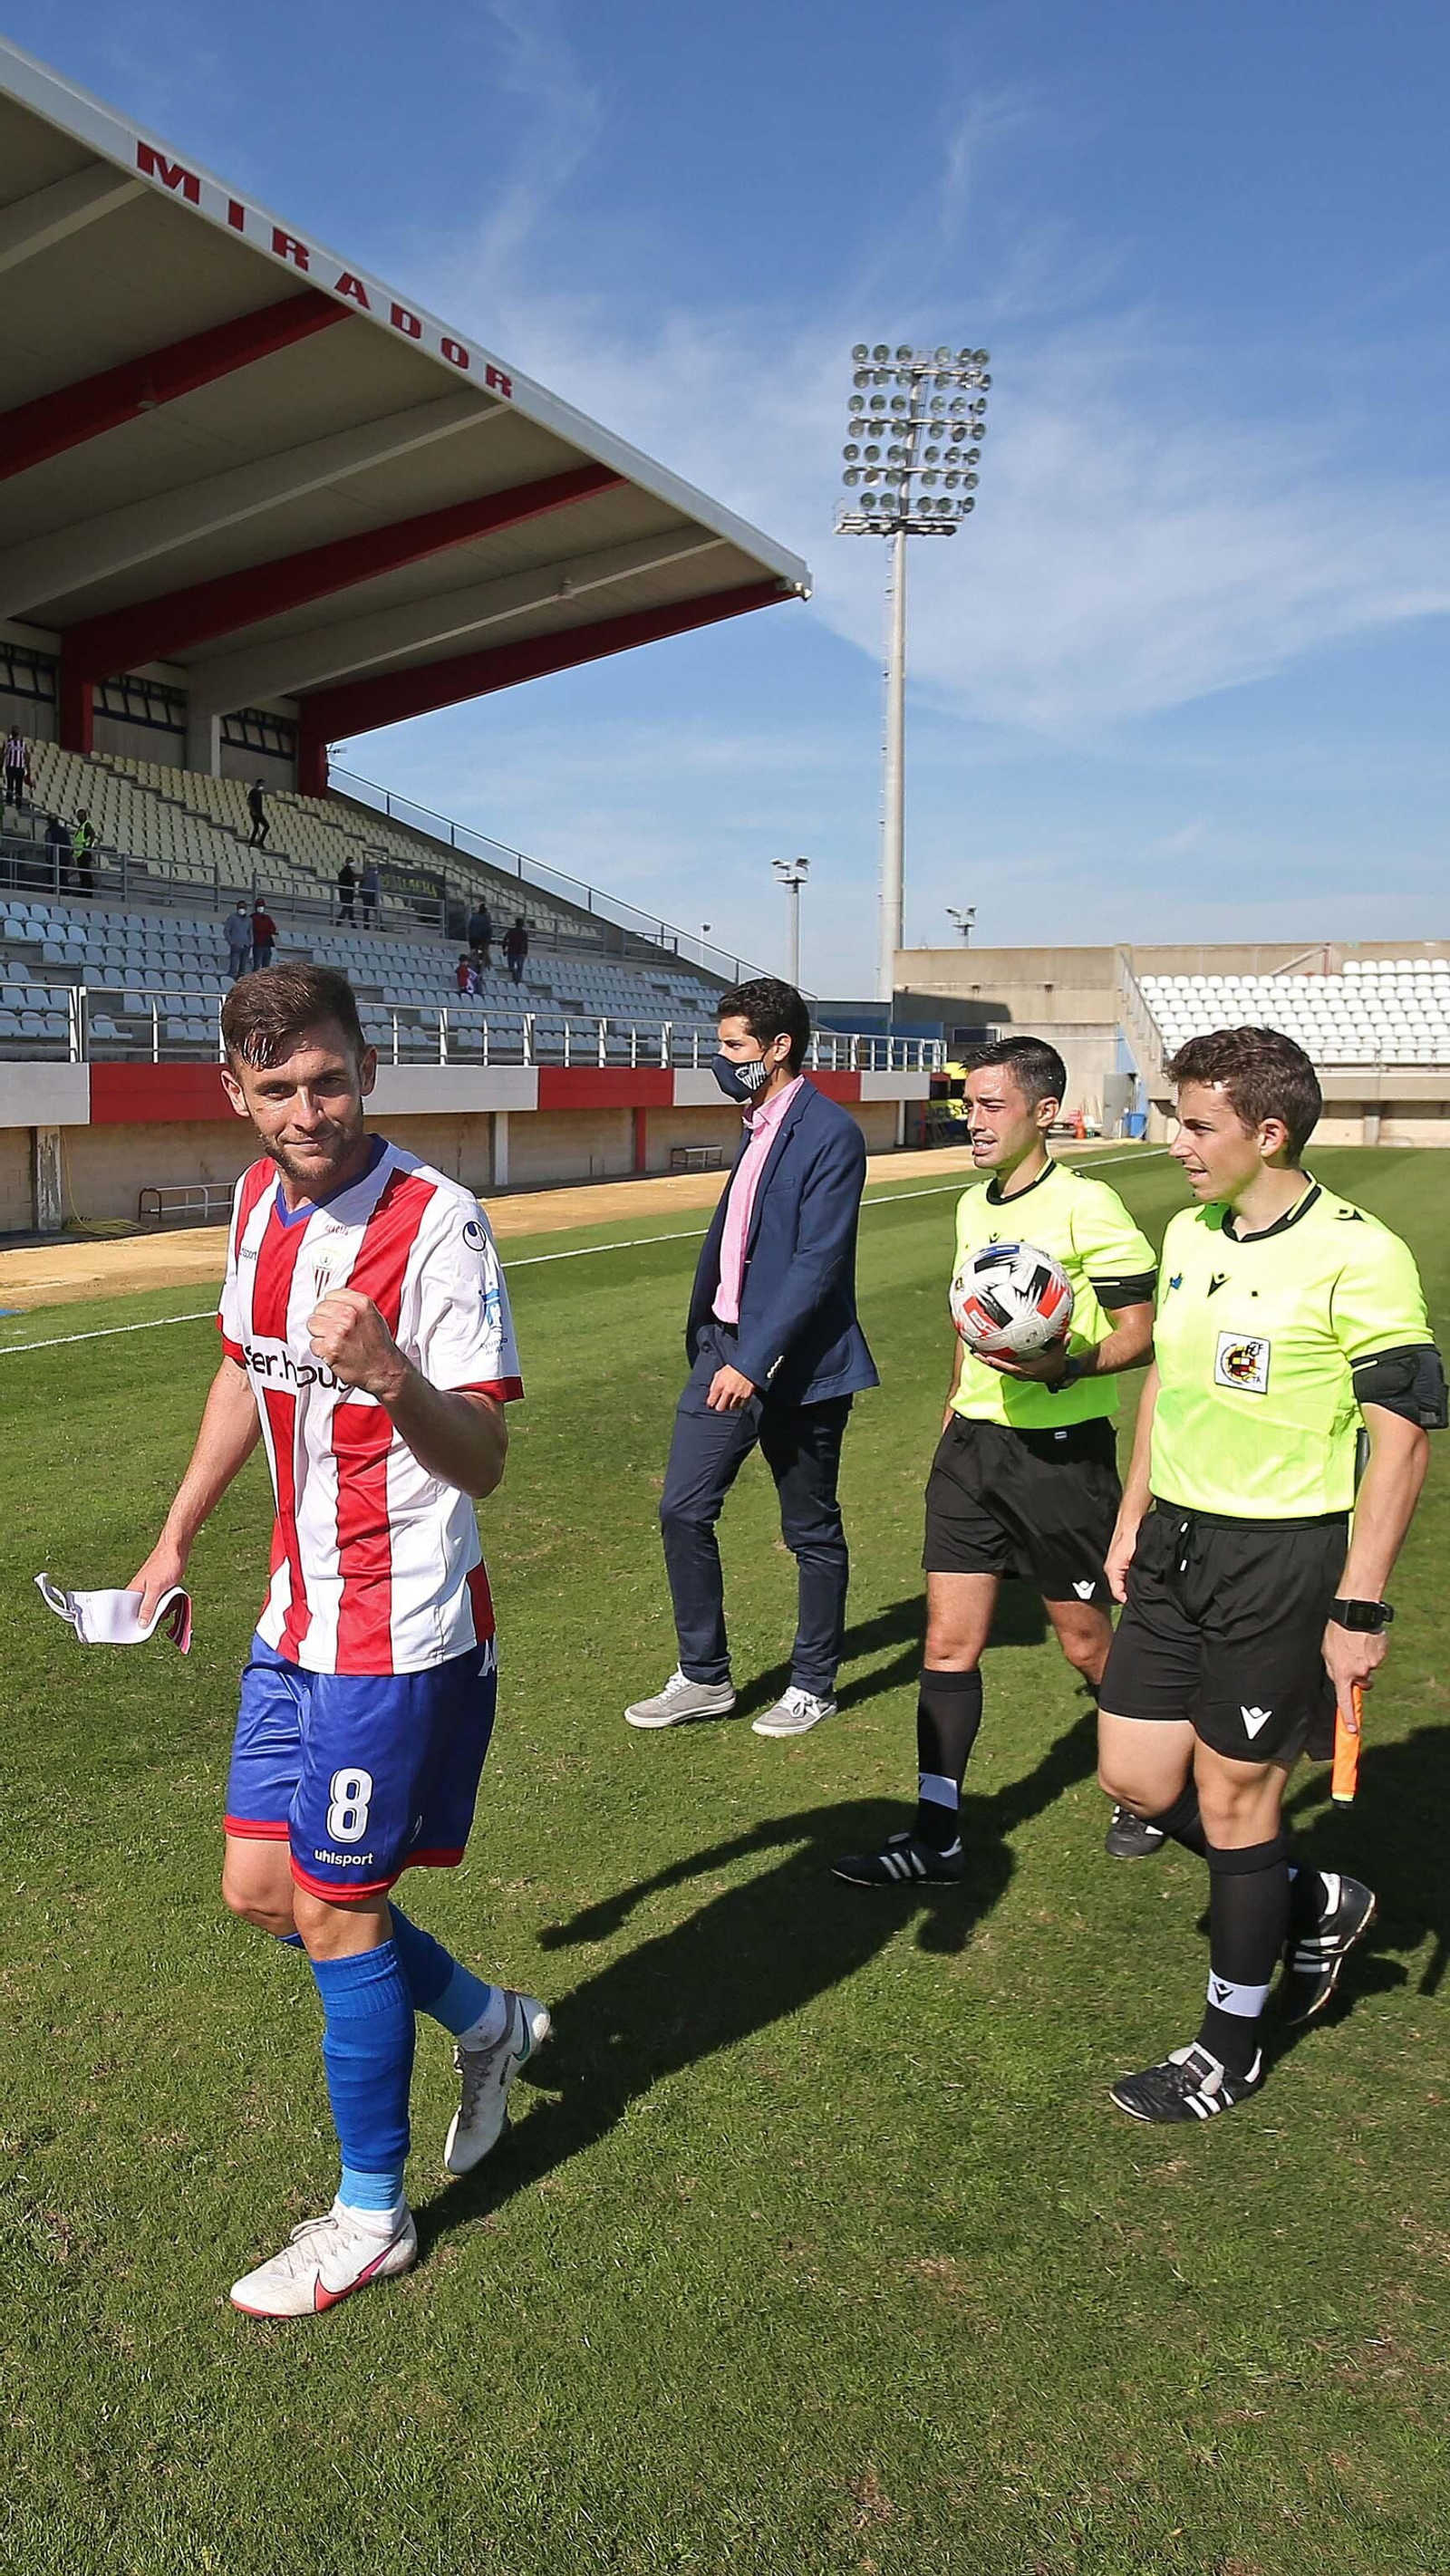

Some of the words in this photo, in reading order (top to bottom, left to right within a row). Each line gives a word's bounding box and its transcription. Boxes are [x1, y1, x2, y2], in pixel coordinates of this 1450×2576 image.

[137, 140, 513, 399] MIRADOR
[326, 1767, 373, 1844] 8
[314, 1848, 373, 1867] uhlsport
